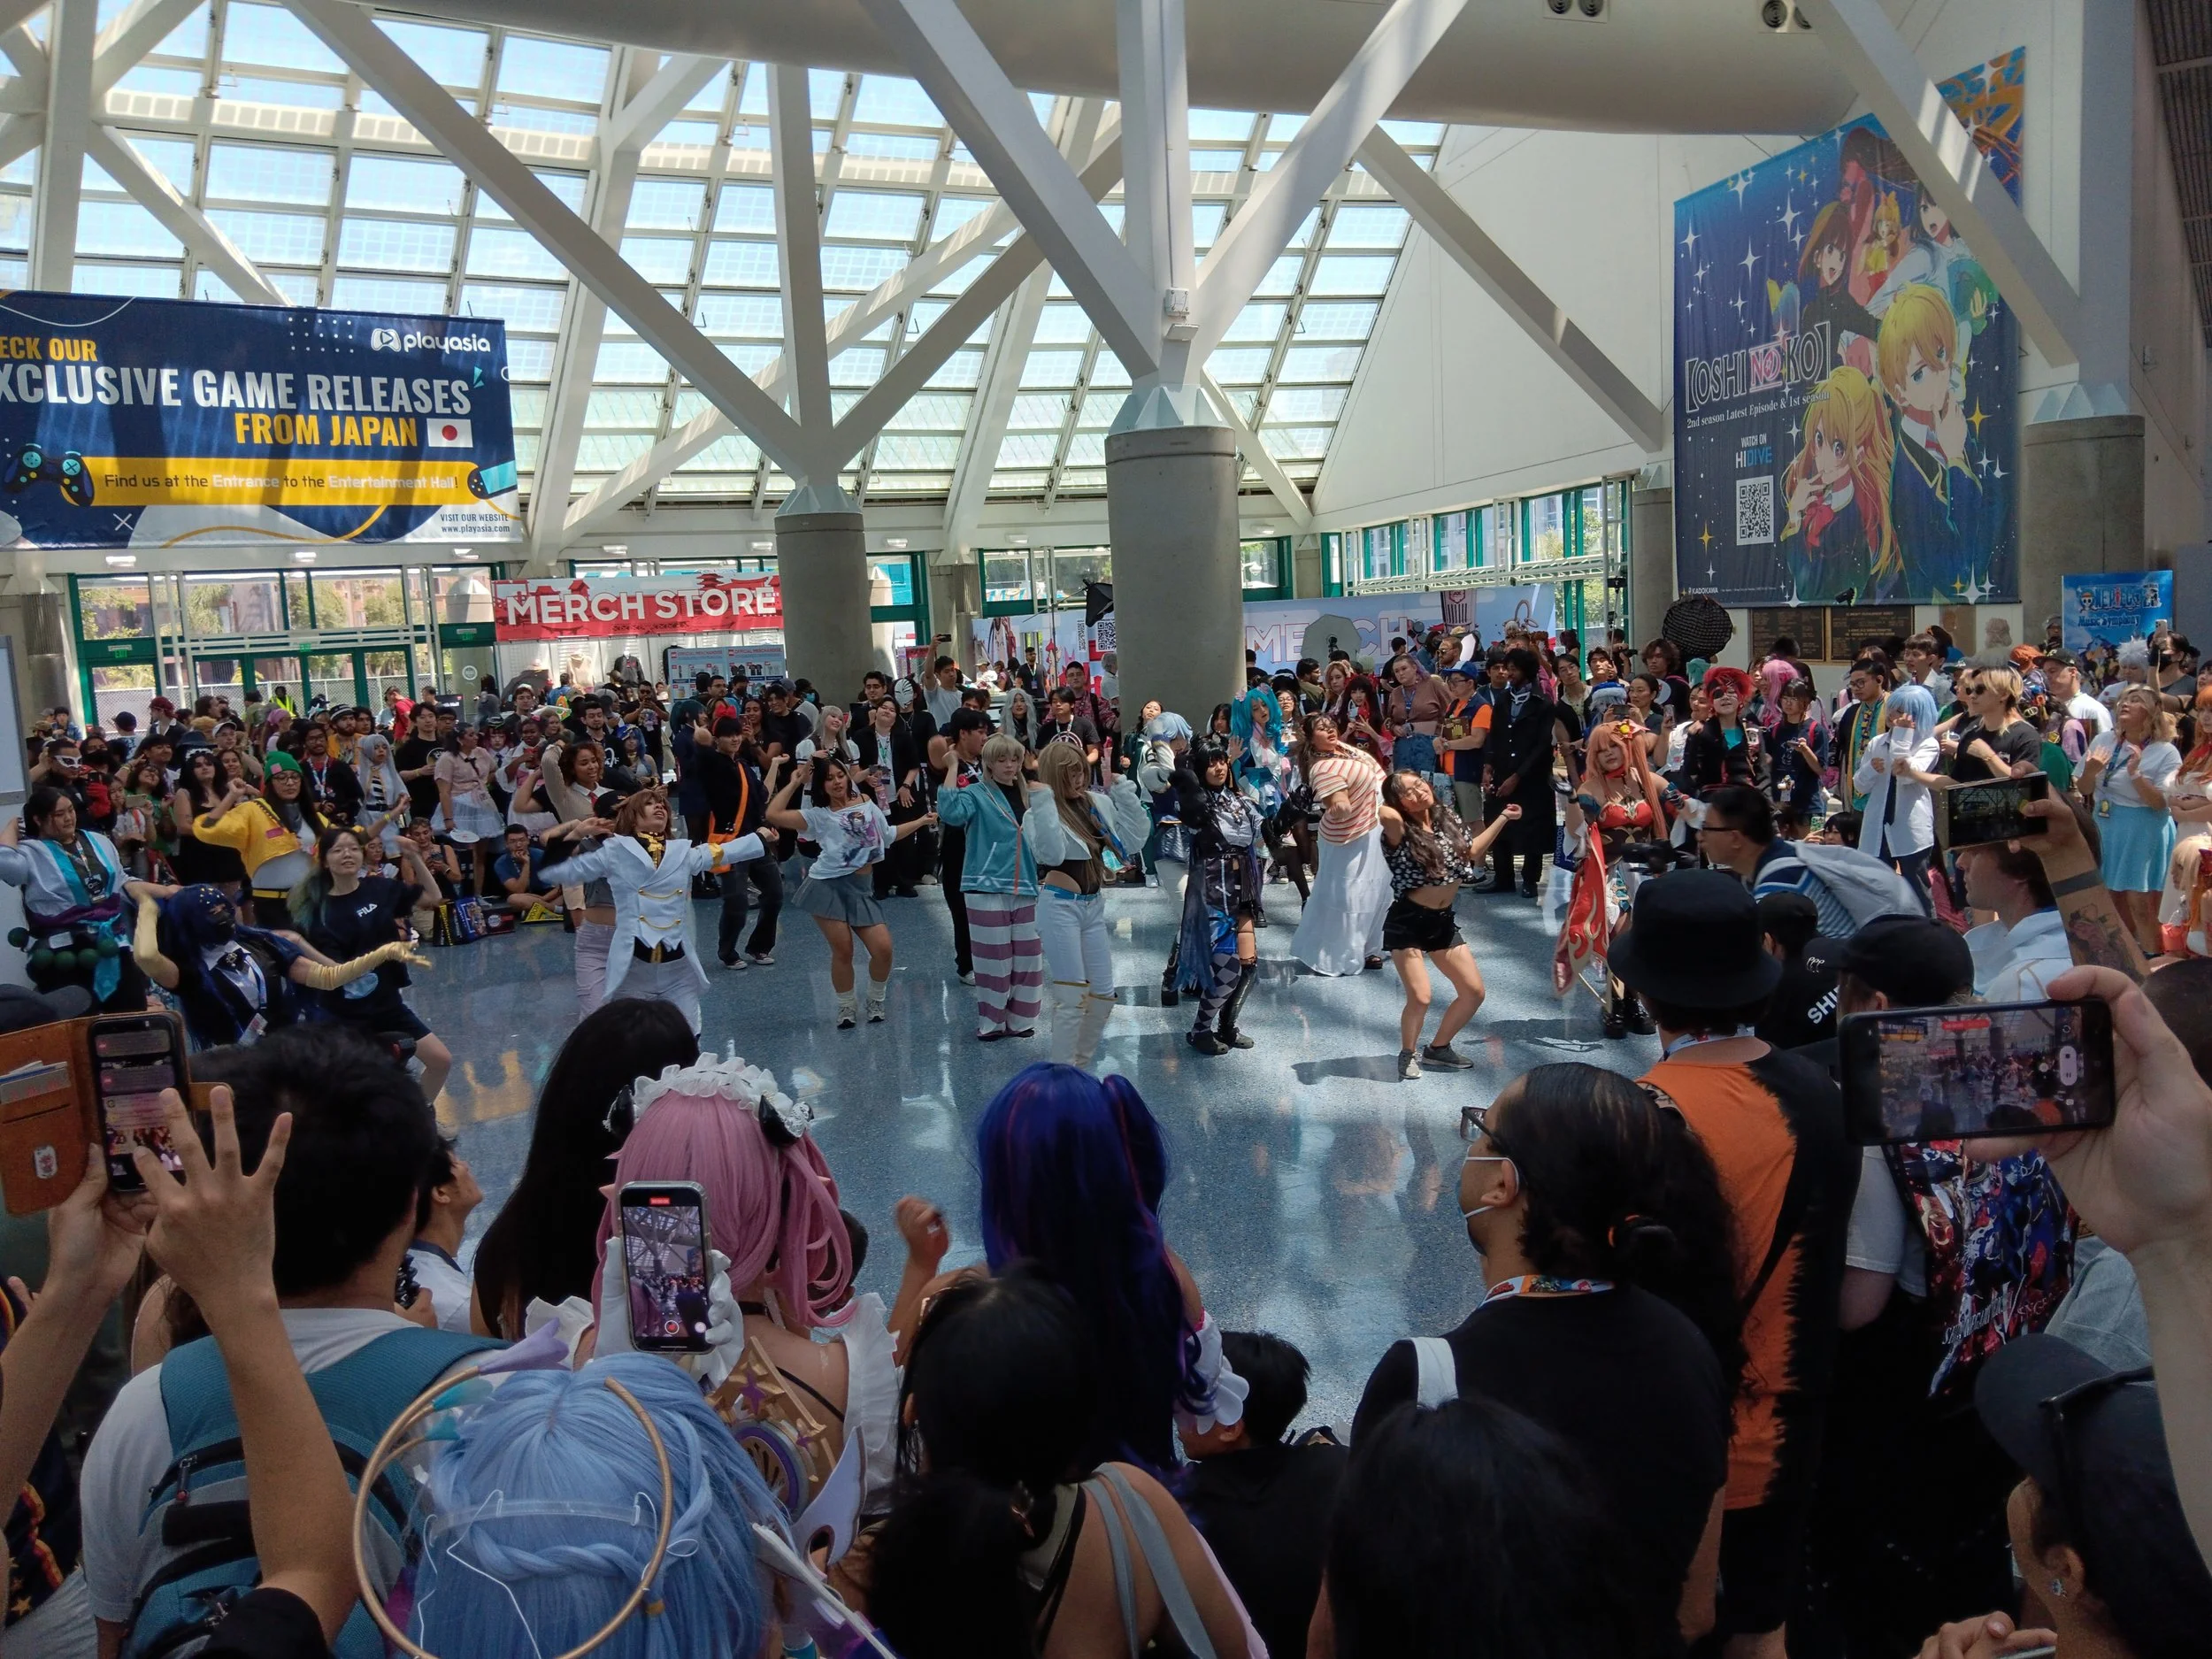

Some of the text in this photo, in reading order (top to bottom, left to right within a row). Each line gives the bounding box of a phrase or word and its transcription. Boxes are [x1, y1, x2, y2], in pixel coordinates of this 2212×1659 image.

[49, 338, 97, 362] OUR
[404, 332, 490, 354] playasia
[192, 370, 297, 409] GAME
[307, 373, 472, 415] RELEASES
[1686, 392, 1830, 429] 2nd season Latest Episode & 1st season
[234, 412, 418, 447] FROM JAPAN
[1740, 433, 1767, 449] WATCH ON
[1735, 446, 1772, 468] HIDIVE
[104, 474, 137, 488] Find
[142, 477, 160, 488] us
[165, 475, 179, 488] at
[184, 475, 208, 488] the
[212, 474, 280, 488] Entrance
[283, 476, 298, 488] to
[303, 476, 325, 488] the
[328, 476, 427, 489] Entertainment
[441, 513, 509, 523] VISIT OUR WEBSITE
[441, 523, 511, 534] www.playasia.com
[507, 587, 777, 626] MERCH STORE
[1246, 617, 1408, 664] MECH
[357, 903, 378, 918] FILA
